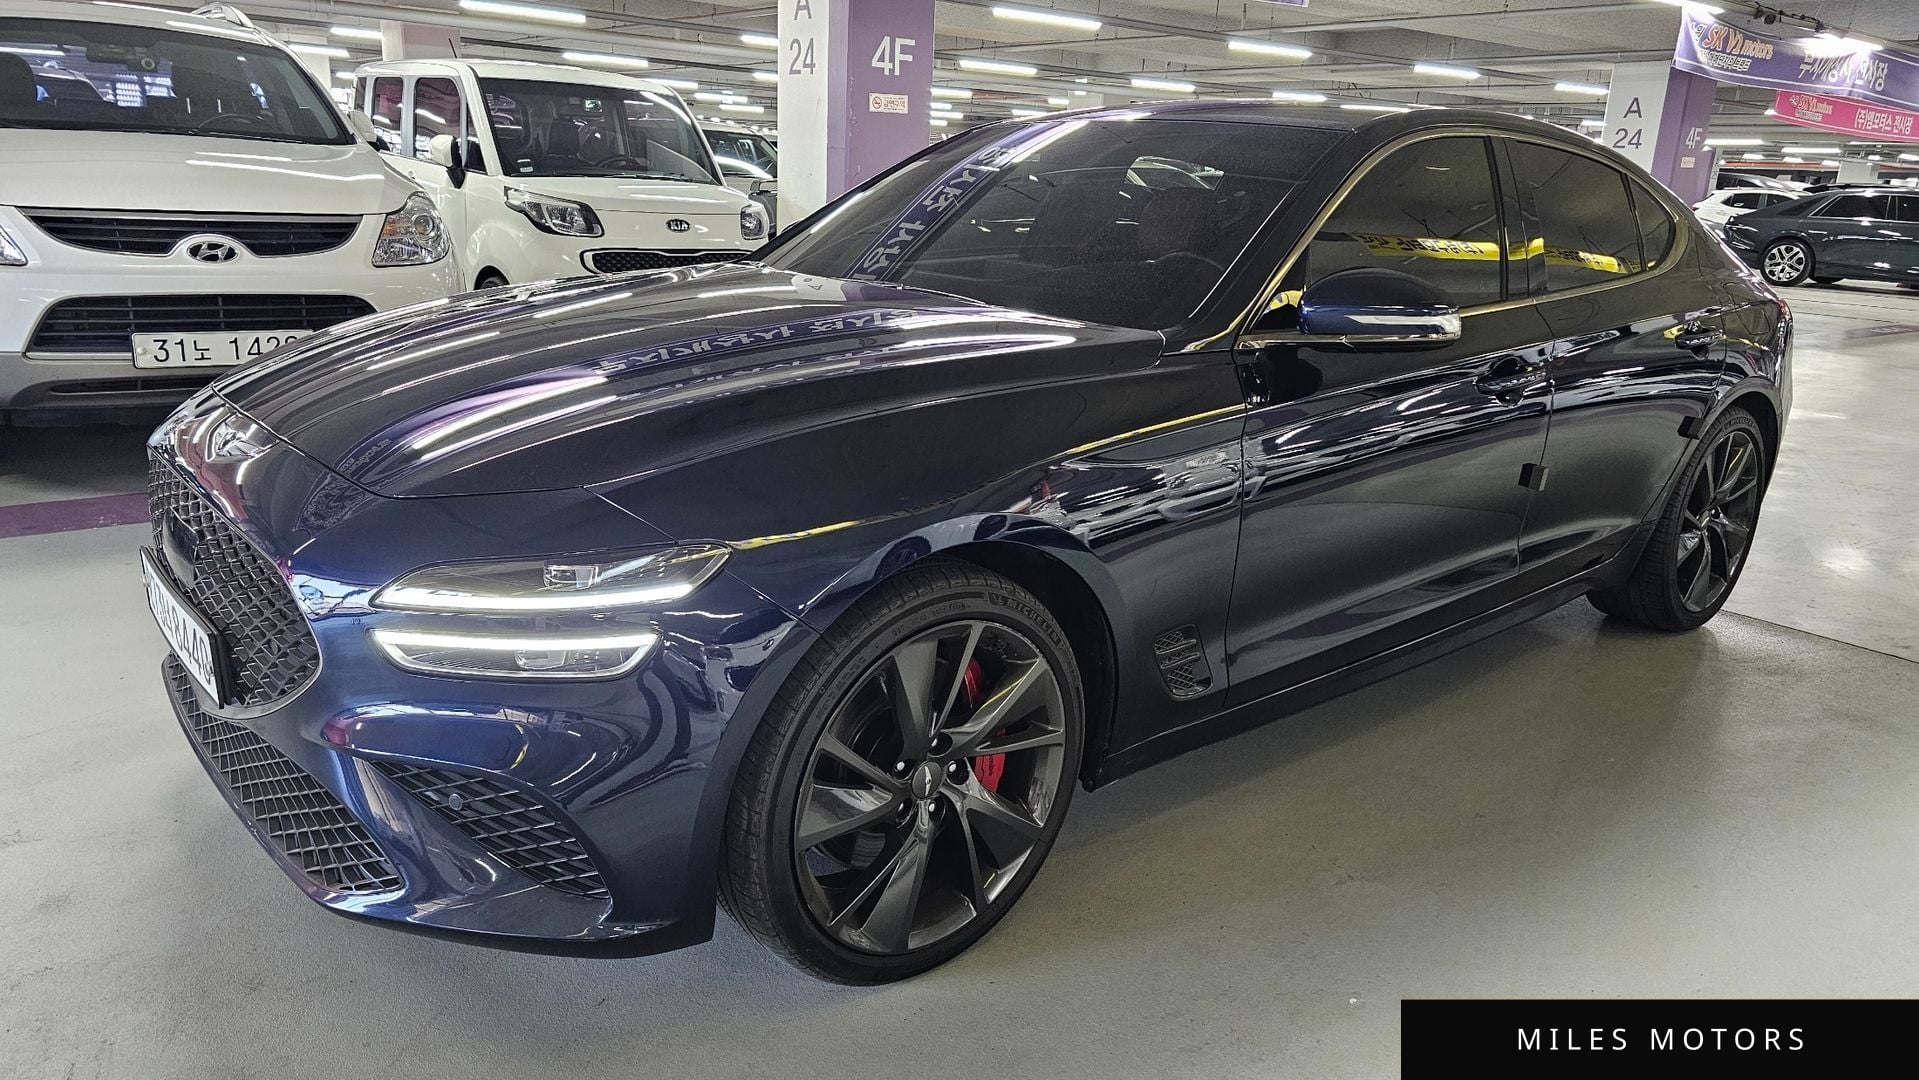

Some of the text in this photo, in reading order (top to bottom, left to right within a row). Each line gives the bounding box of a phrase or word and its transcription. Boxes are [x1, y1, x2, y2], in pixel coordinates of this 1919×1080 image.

[794, 0, 812, 20] A
[1702, 23, 1728, 51] SK
[1740, 40, 1774, 60] motors
[789, 38, 816, 75] 24
[871, 36, 916, 76] 4F
[1623, 97, 1642, 118] A
[1612, 128, 1643, 149] 24
[1685, 127, 1703, 149] 4F
[670, 221, 689, 230] KIA
[152, 338, 212, 363] 31노
[1005, 598, 1060, 642] MICHELIN
